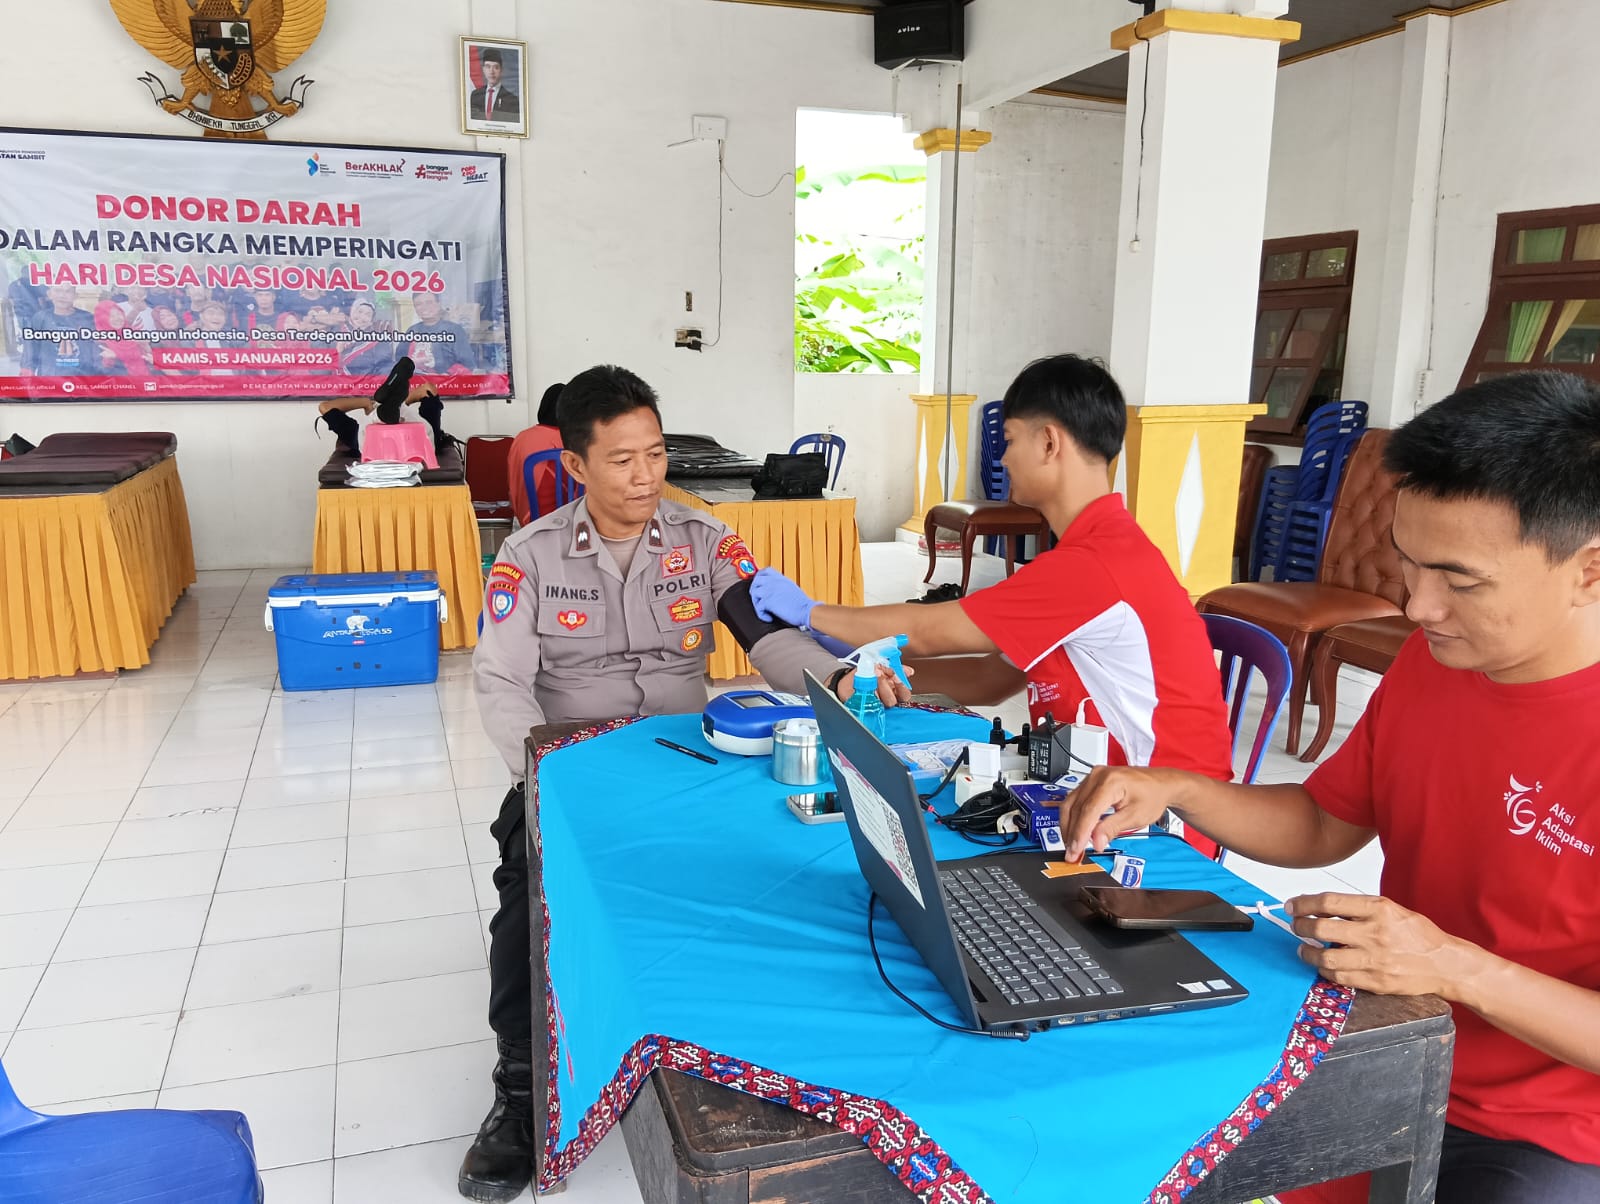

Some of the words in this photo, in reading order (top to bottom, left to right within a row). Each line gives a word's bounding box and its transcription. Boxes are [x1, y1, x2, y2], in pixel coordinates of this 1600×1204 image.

[231, 121, 263, 131] TUNGGAL
[345, 159, 405, 173] BerAKHLAK
[95, 194, 230, 222] DONOR
[235, 199, 361, 227] DARAH
[107, 230, 239, 255] RANGKA
[246, 233, 462, 261] MEMPERINGATI
[30, 263, 108, 286] HARI
[115, 264, 201, 287] DESA
[207, 265, 368, 291] NASIONAL
[373, 270, 445, 293] 2026
[24, 328, 78, 341] Bangun
[81, 328, 120, 340] Desa,
[123, 329, 177, 341] Bangun
[179, 329, 249, 341] Indonesia,
[252, 329, 286, 341] Desa
[288, 330, 351, 342] Terdepan
[353, 331, 392, 342] Untuk
[394, 331, 455, 342] Indonesia
[162, 353, 213, 366] KAMIS,
[215, 353, 229, 365] 15
[232, 353, 295, 365] JANUARI
[298, 353, 333, 365] 2026
[545, 585, 600, 601] INANG.S
[654, 574, 706, 597] POLRI
[1548, 802, 1576, 827] Aksi
[1535, 829, 1562, 856] Iklim
[1541, 816, 1596, 857] Adaptasi
